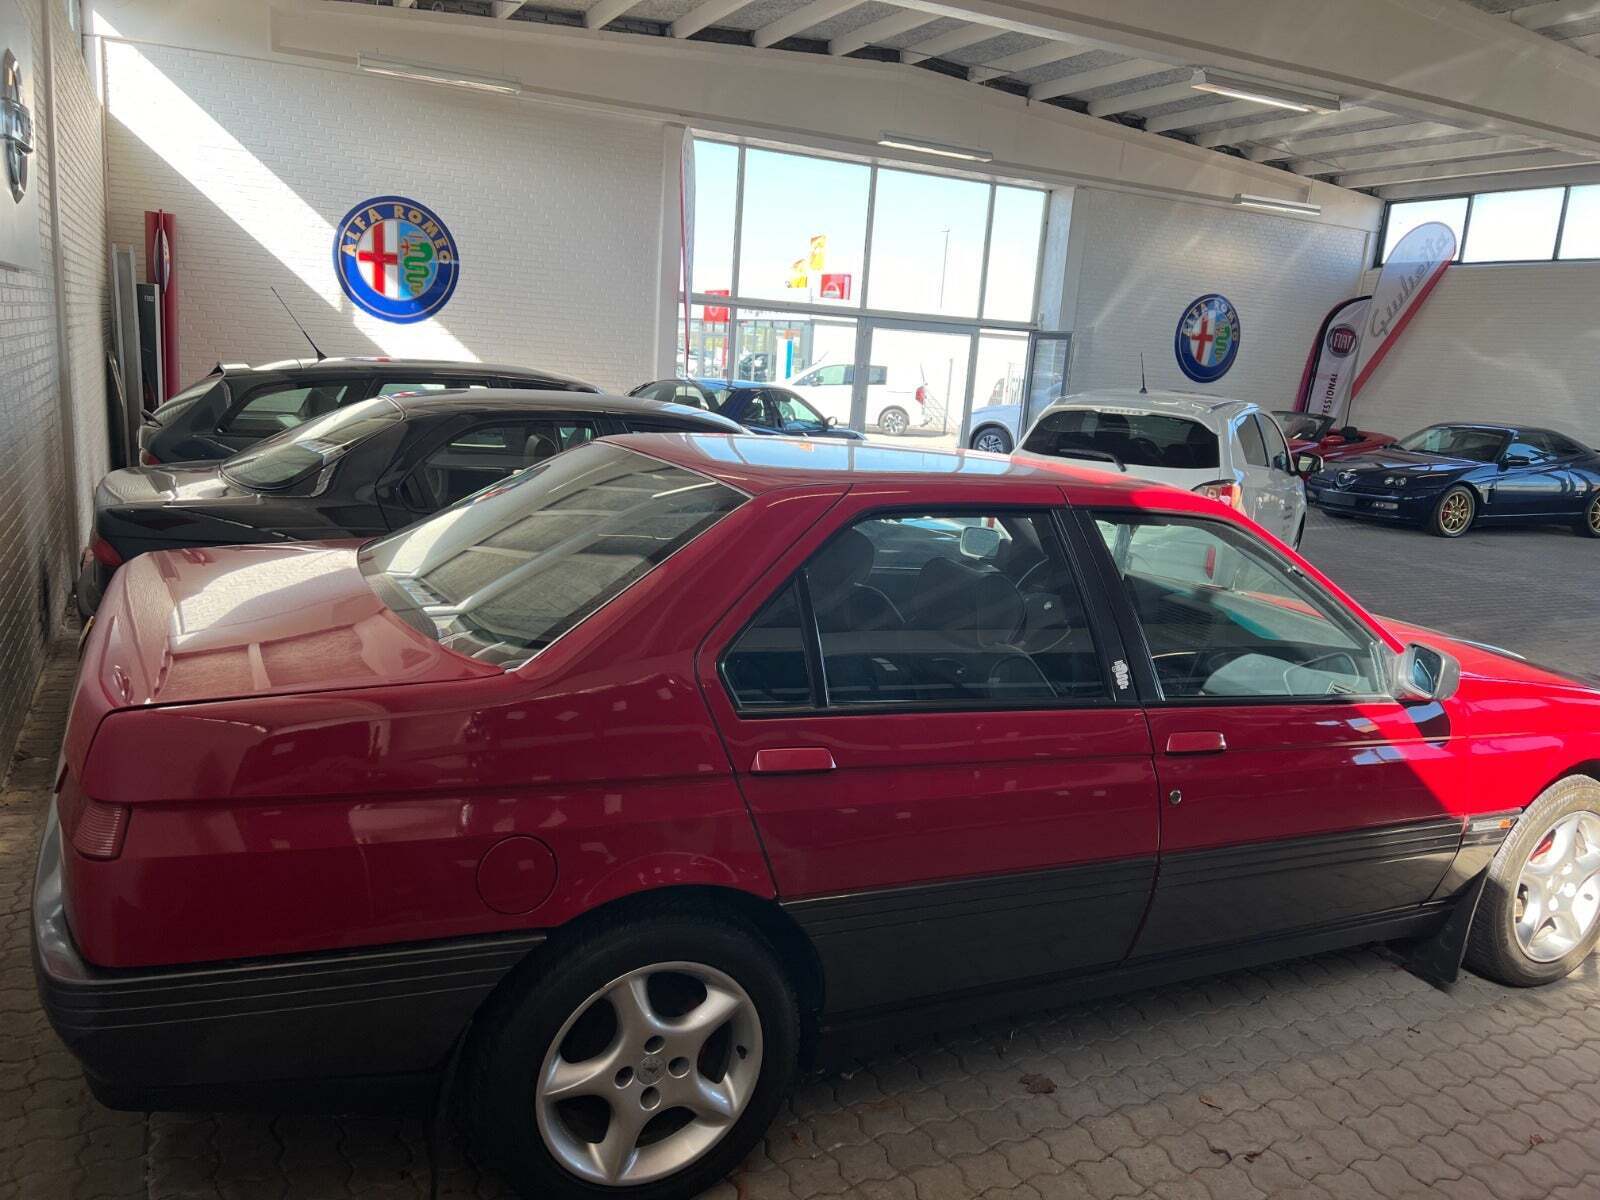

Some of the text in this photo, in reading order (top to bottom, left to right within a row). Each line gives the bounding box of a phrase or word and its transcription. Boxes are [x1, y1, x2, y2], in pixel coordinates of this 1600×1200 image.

[341, 205, 452, 265] ALFA ROMEO
[1333, 331, 1353, 350] FIAT
